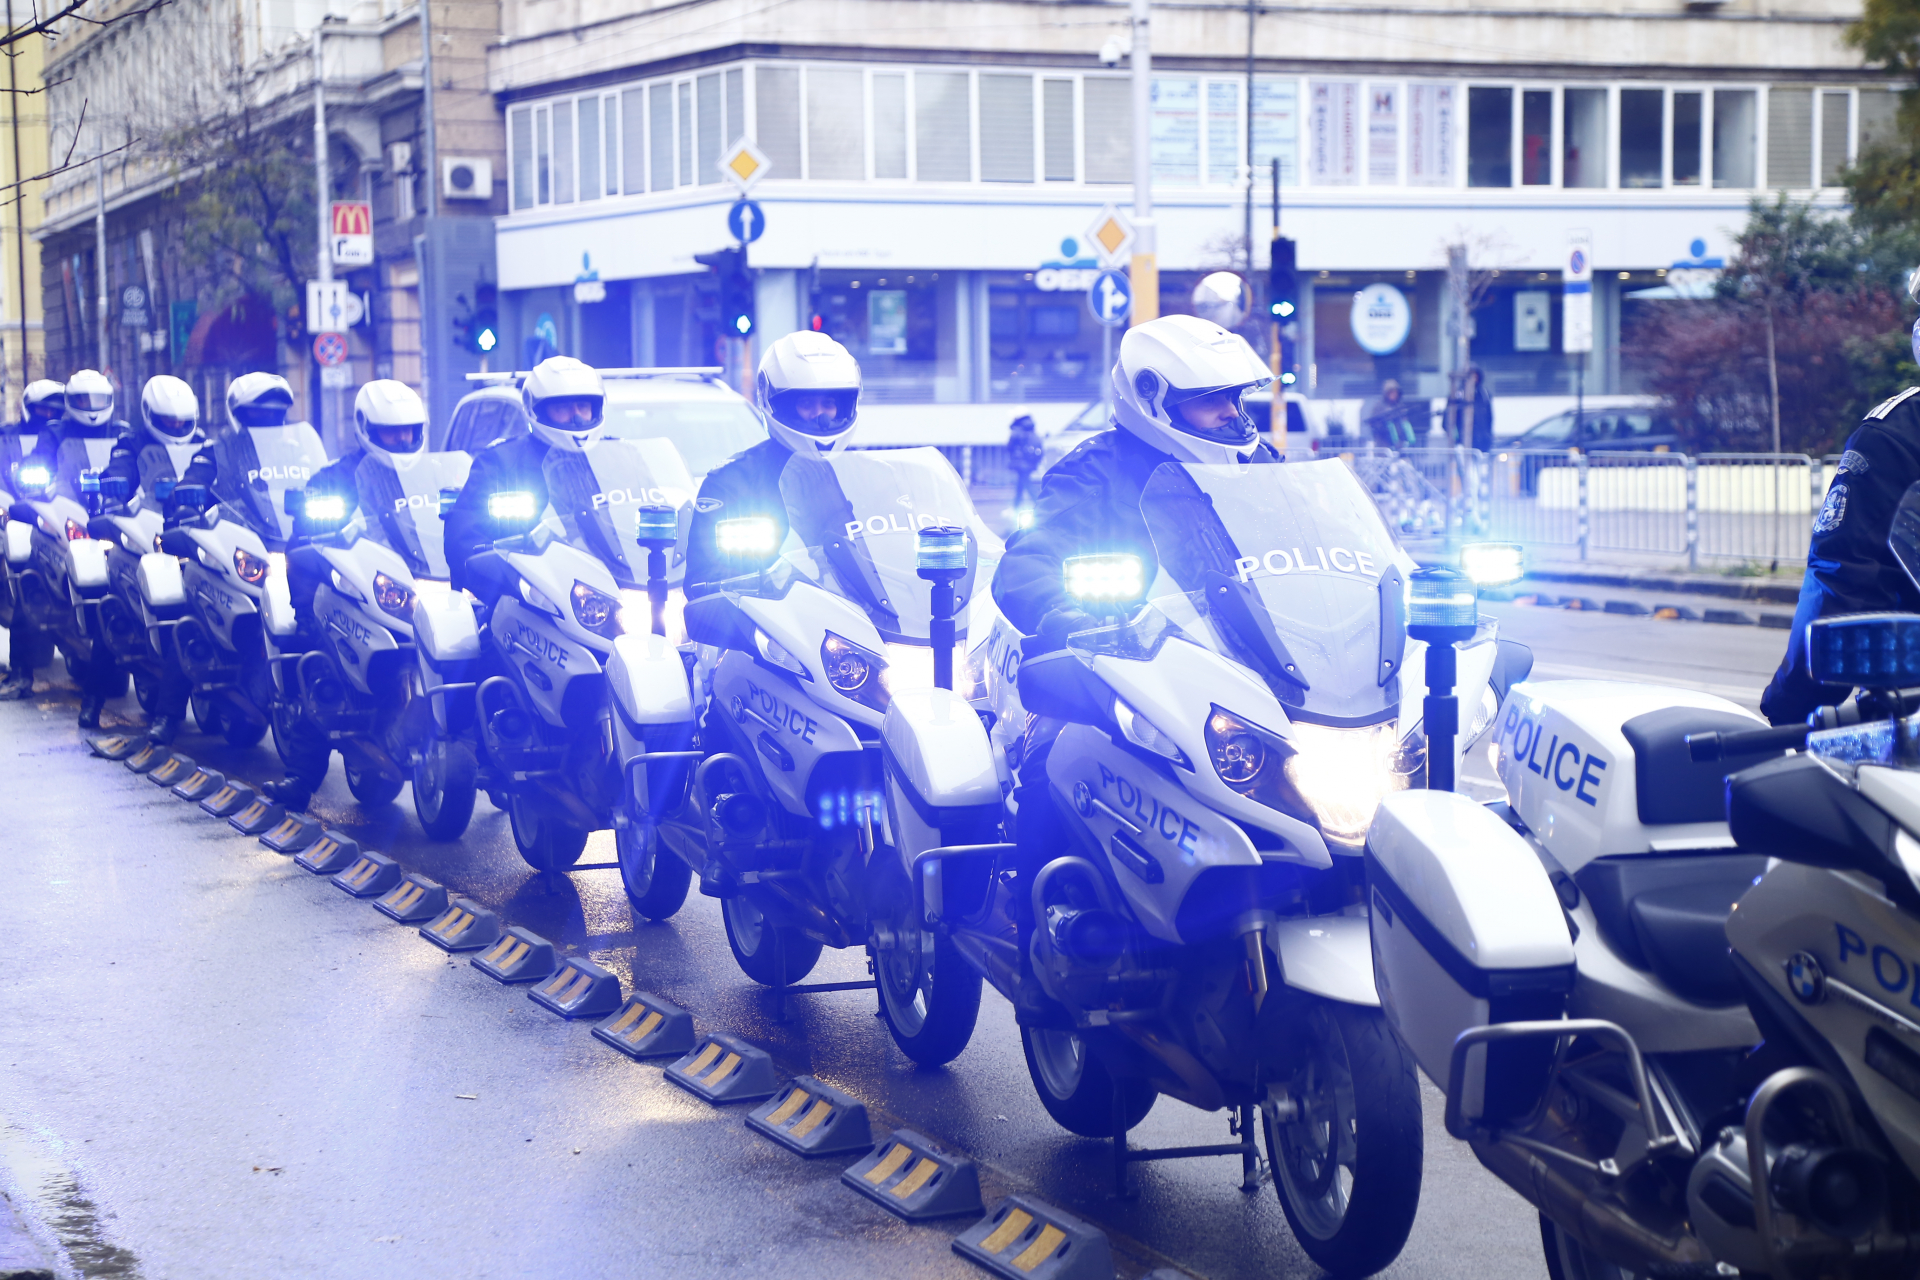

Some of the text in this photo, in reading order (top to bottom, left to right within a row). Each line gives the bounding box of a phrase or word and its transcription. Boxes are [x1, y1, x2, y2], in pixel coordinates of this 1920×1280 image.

[247, 465, 311, 484] POLICE
[394, 493, 438, 514] POL
[591, 487, 665, 511] POLIC
[1234, 546, 1380, 584] POLICE
[333, 609, 372, 647] POLICE
[516, 619, 570, 670] POLICE
[746, 679, 818, 746] POLICE
[1500, 703, 1608, 808] POLICE
[1097, 760, 1200, 857] POLICE
